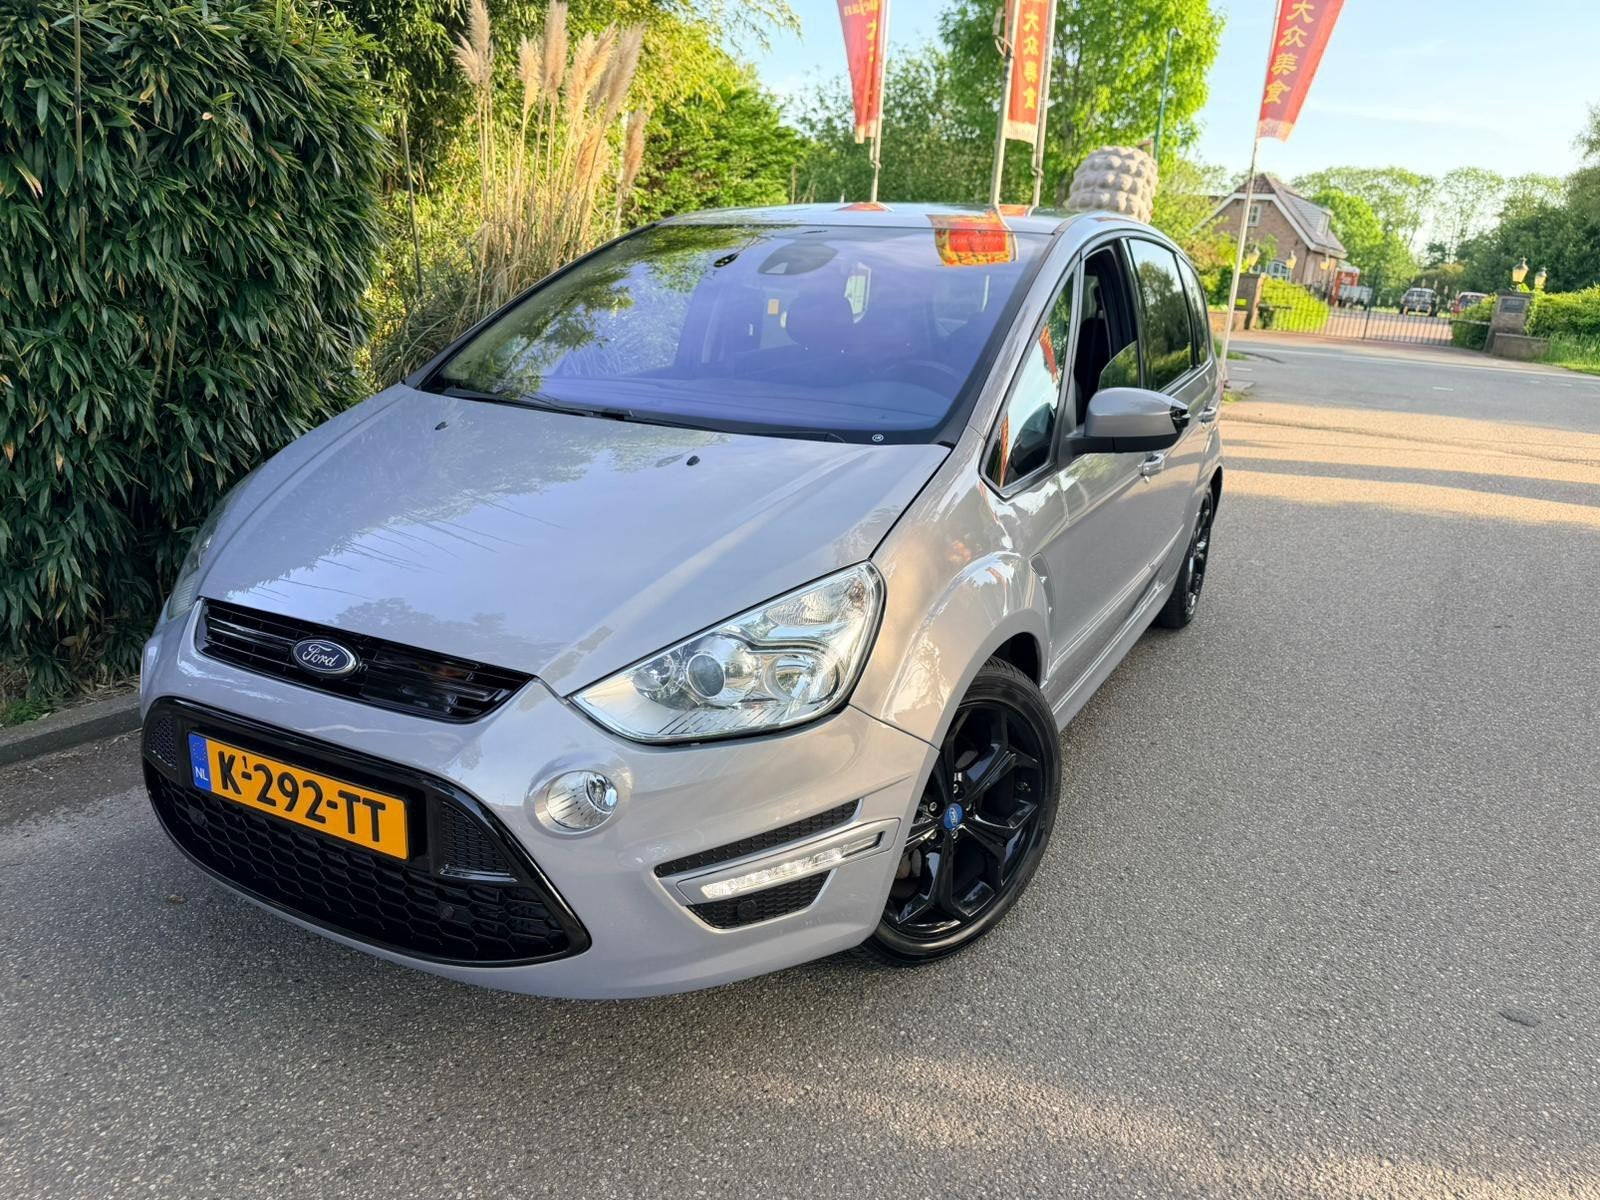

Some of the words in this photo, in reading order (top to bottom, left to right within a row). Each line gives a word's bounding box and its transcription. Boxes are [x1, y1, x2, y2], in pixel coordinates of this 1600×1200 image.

[1263, 0, 1315, 105] 大众美食
[302, 643, 340, 667] Ford
[194, 766, 209, 781] NL
[218, 751, 386, 842] K-292-TT
